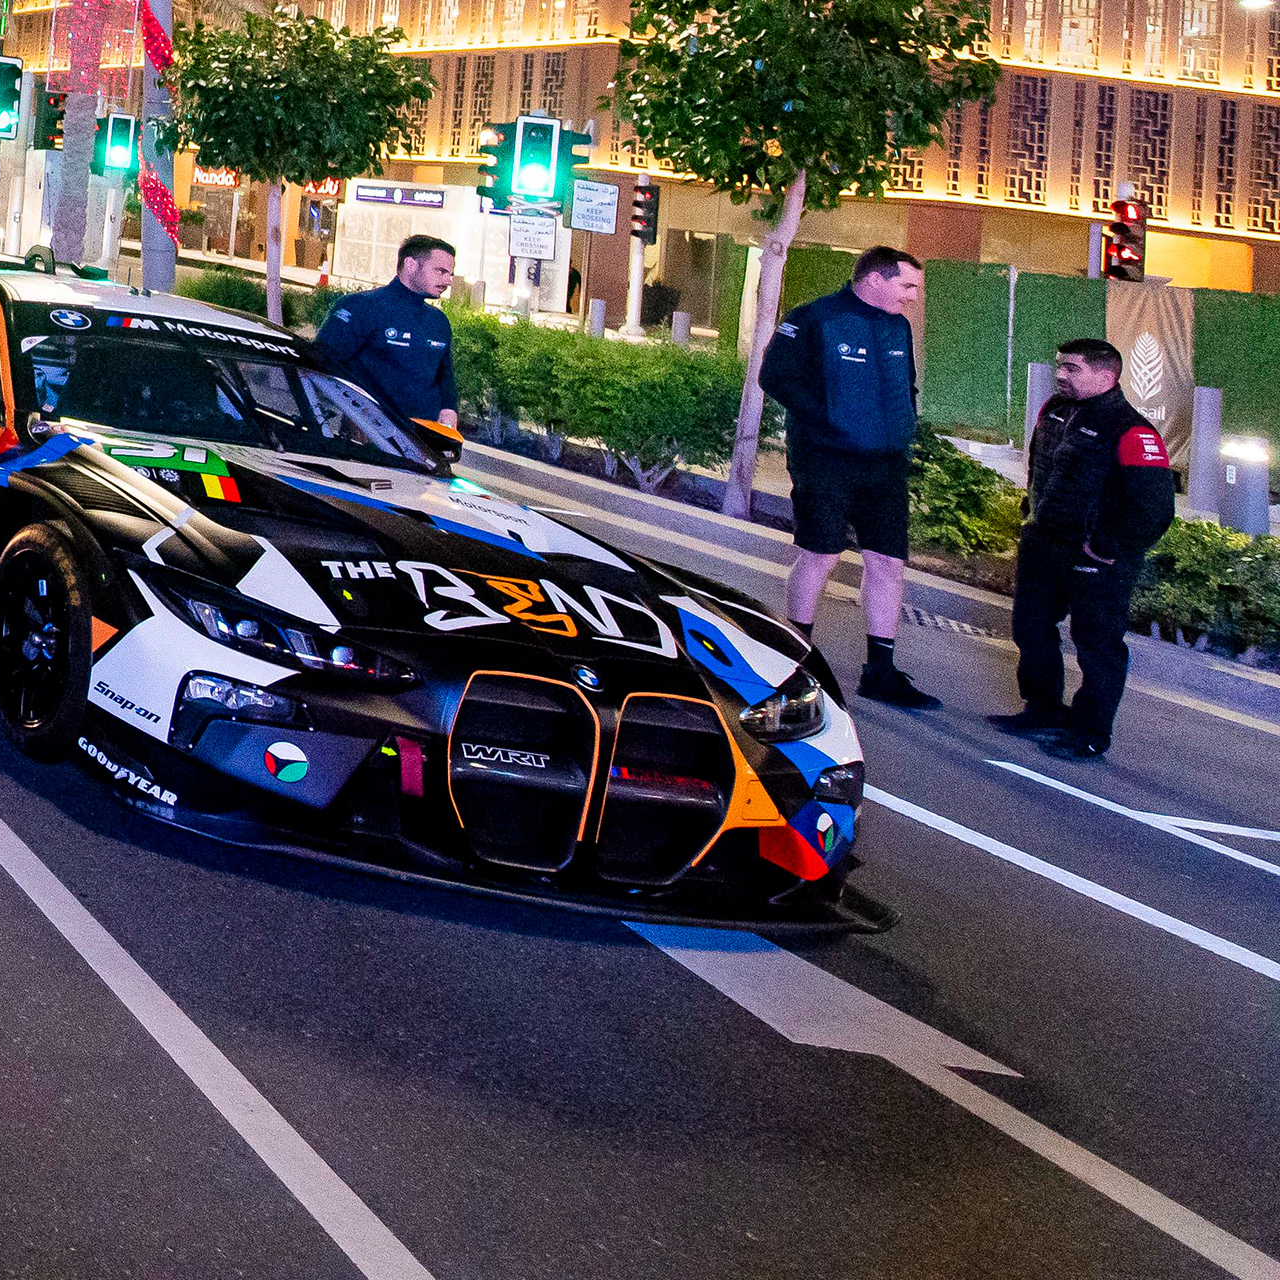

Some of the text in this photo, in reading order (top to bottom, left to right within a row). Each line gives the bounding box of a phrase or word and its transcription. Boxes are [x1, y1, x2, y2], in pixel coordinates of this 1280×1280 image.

[576, 214, 611, 224] CROSSING
[586, 207, 604, 215] KEEP
[583, 222, 604, 230] CLEAR
[515, 241, 549, 250] CROSSING
[163, 320, 300, 358] Motorsport
[448, 495, 532, 527] Motorsport
[321, 560, 396, 580] THE
[93, 680, 162, 724] Snap-on
[461, 742, 550, 768] WRT
[78, 736, 178, 806] GOODYEAR
